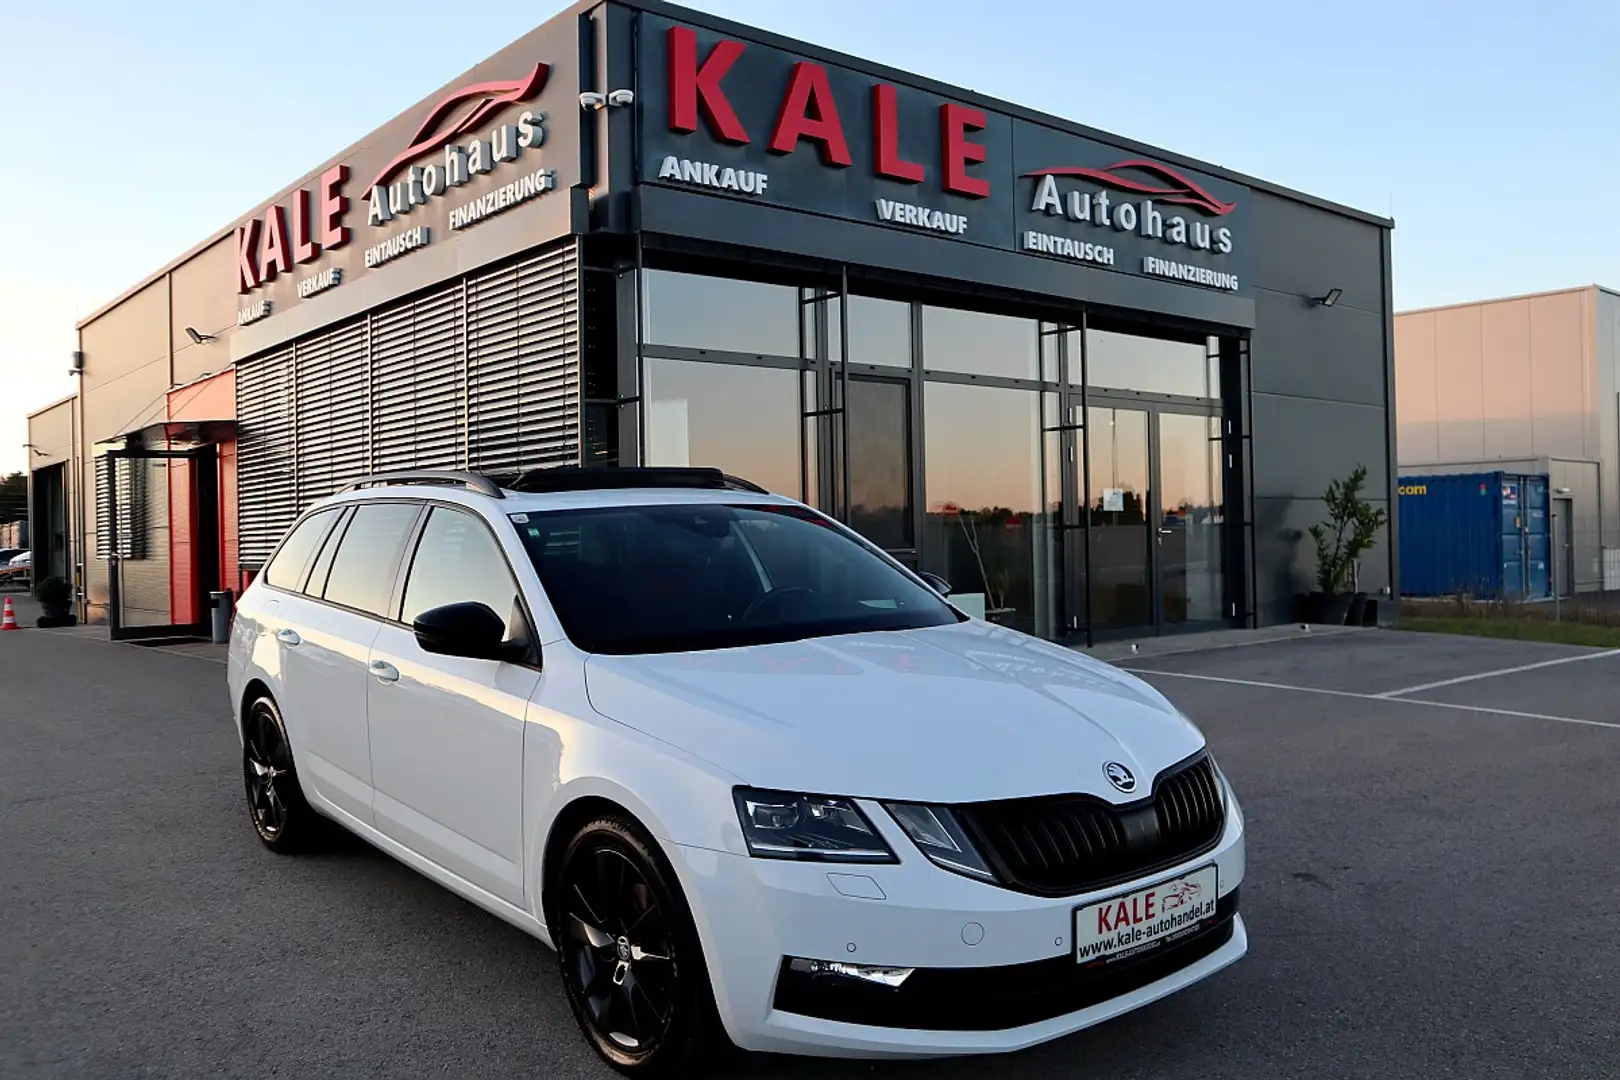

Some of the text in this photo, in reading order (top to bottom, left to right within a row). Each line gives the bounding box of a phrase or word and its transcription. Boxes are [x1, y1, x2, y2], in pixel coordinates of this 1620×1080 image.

[367, 110, 547, 226] Autohaus
[667, 25, 990, 199] KALE
[234, 164, 350, 294] KALE
[237, 168, 556, 326] ANKAUF VERKAUF EINTAUSCH FINANZIERUNG
[658, 155, 1239, 291] ANKAUF VERKAUF EINTAUSCH FINANZIERUNG
[1031, 173, 1234, 254] Autohaus
[1079, 898, 1215, 959] www.kale-autohandel.at
[1097, 892, 1157, 935] KALE
